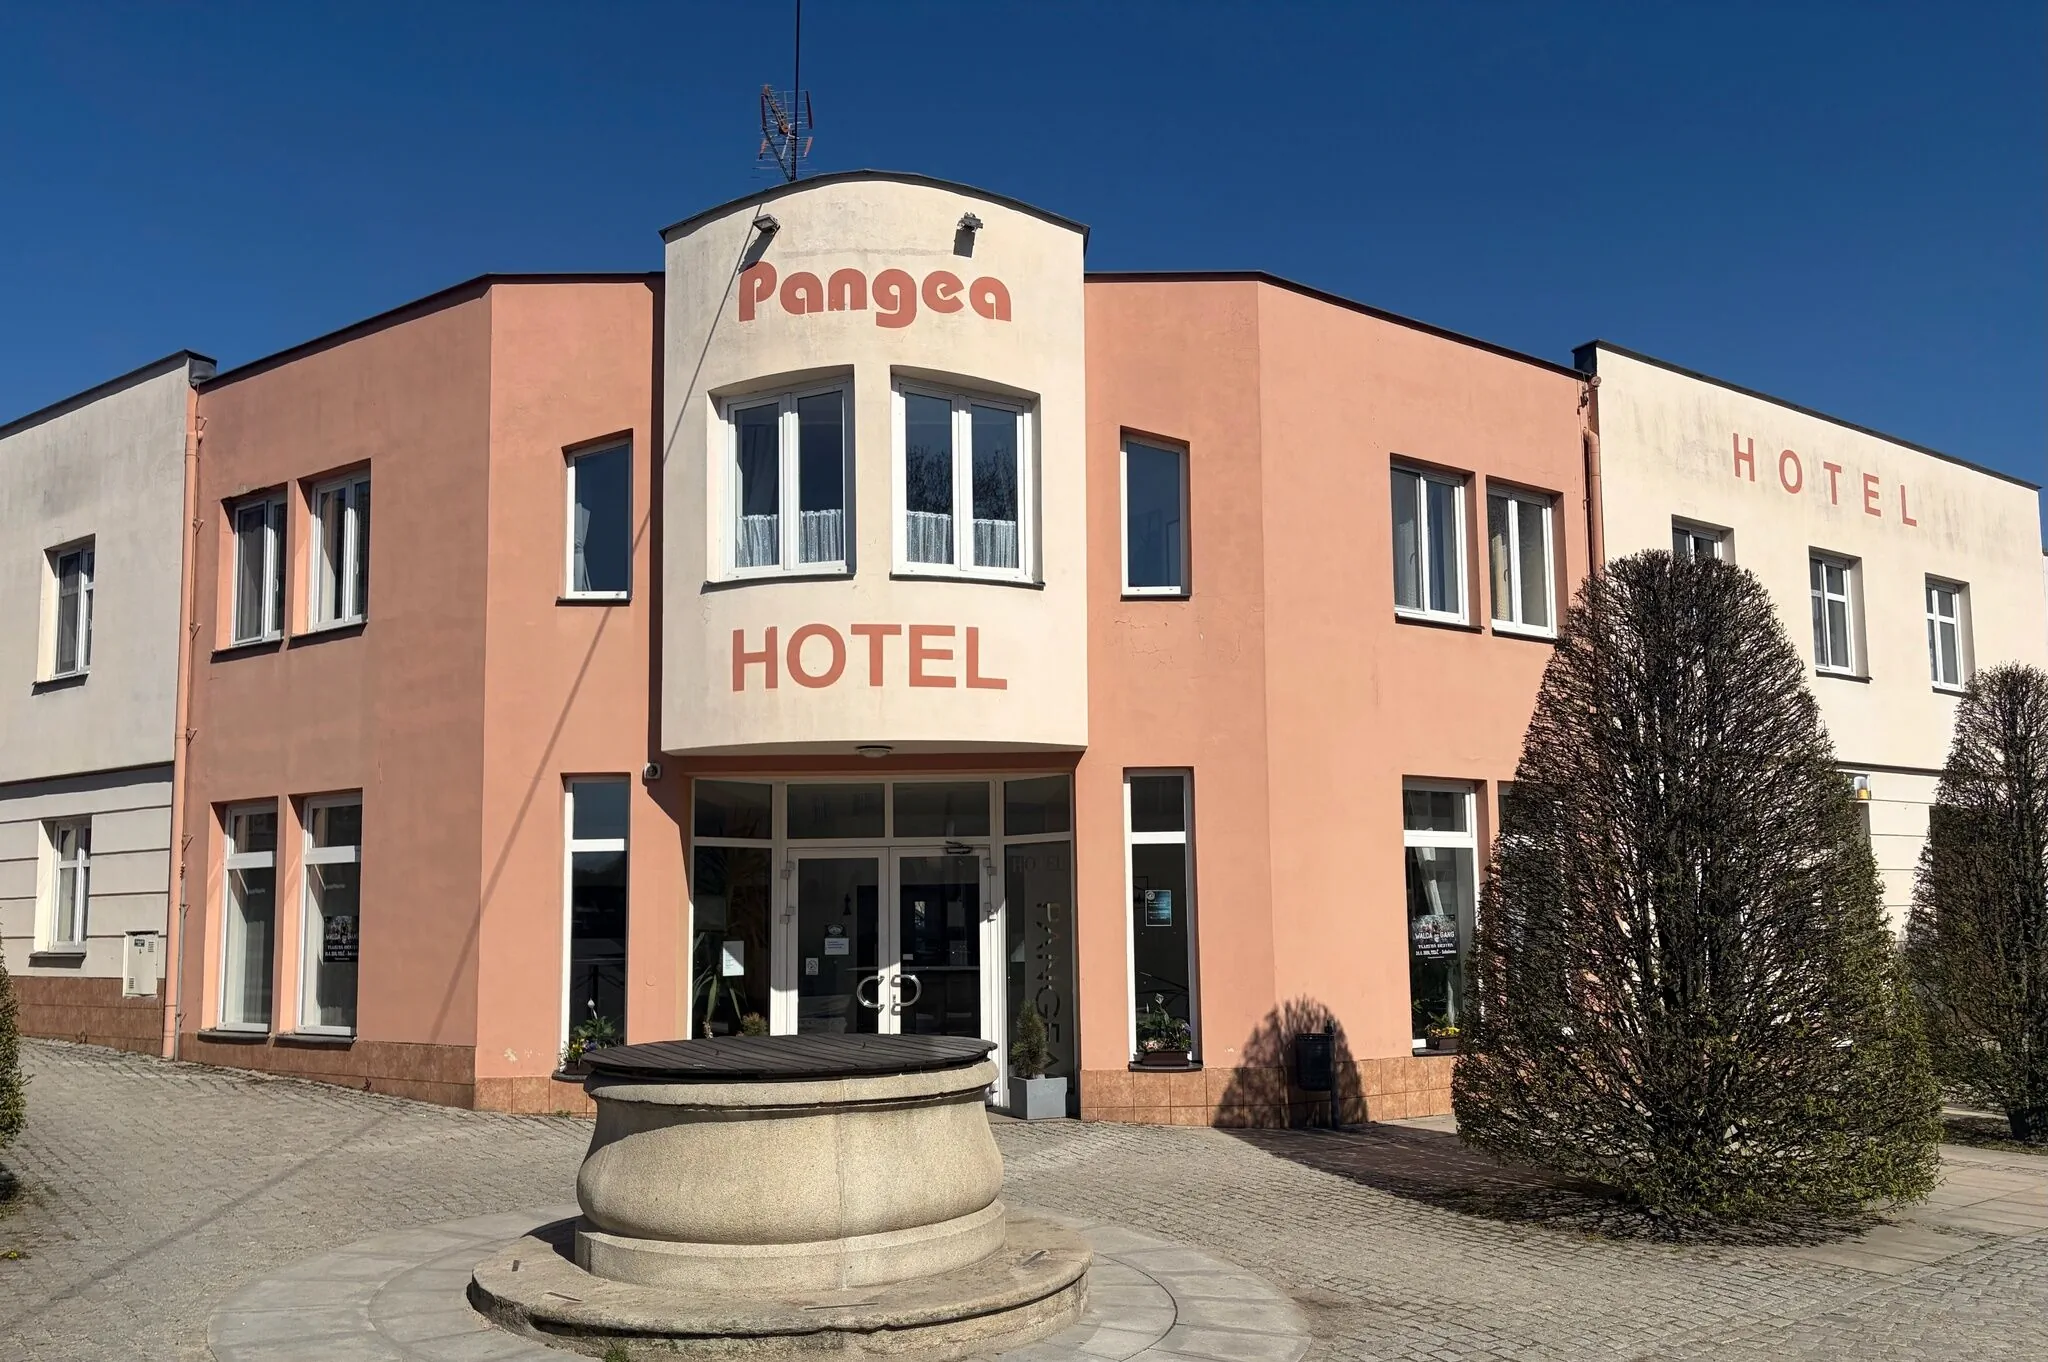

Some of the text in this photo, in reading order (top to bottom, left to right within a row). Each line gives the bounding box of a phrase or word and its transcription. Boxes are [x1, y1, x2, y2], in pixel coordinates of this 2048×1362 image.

[738, 261, 1012, 328] Pangea
[1733, 433, 1917, 527] HOTEL
[732, 623, 1007, 691] HOTEL
